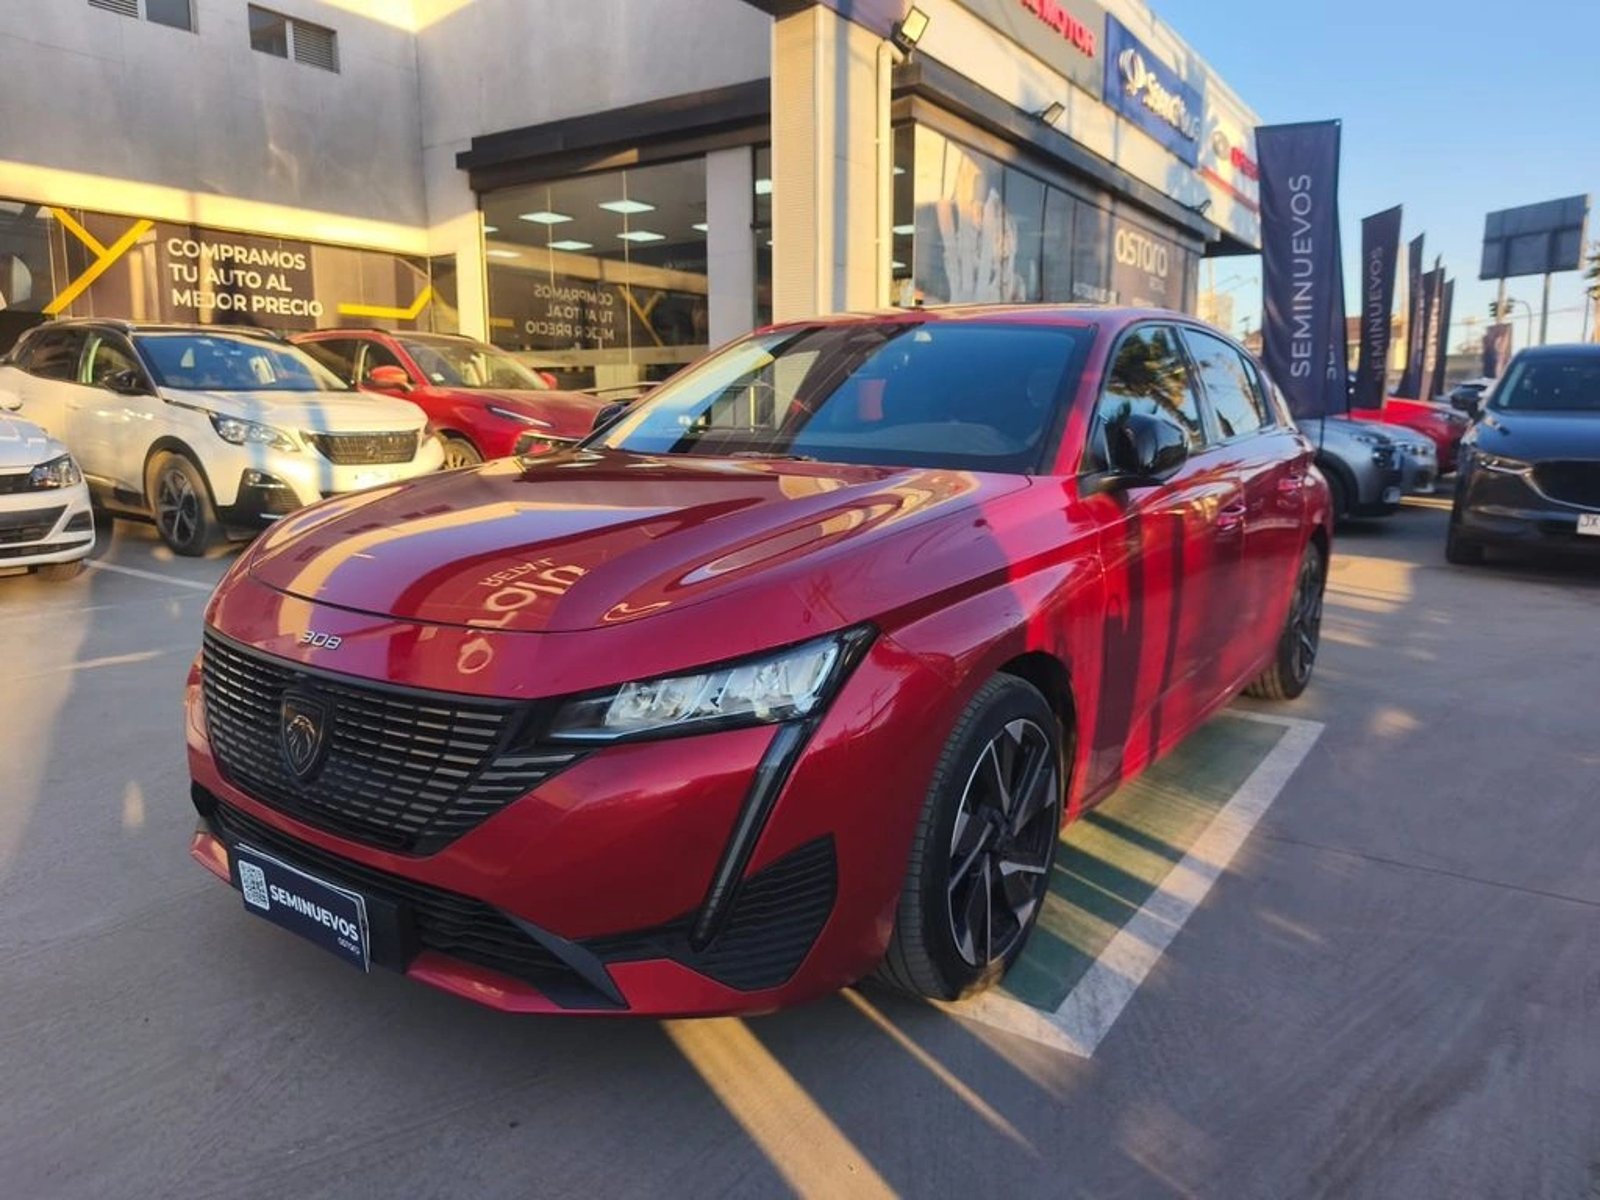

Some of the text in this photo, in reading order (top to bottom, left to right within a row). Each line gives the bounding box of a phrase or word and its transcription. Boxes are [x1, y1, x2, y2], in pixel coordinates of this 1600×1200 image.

[167, 238, 307, 271] COMPRAMOS
[168, 263, 293, 292] TU AUTO AL
[1289, 174, 1313, 378] SEMINUEVOS
[172, 288, 324, 317] MEJOR PRECIO
[300, 630, 342, 650] 308
[269, 884, 360, 942] SEMINUEVOS
